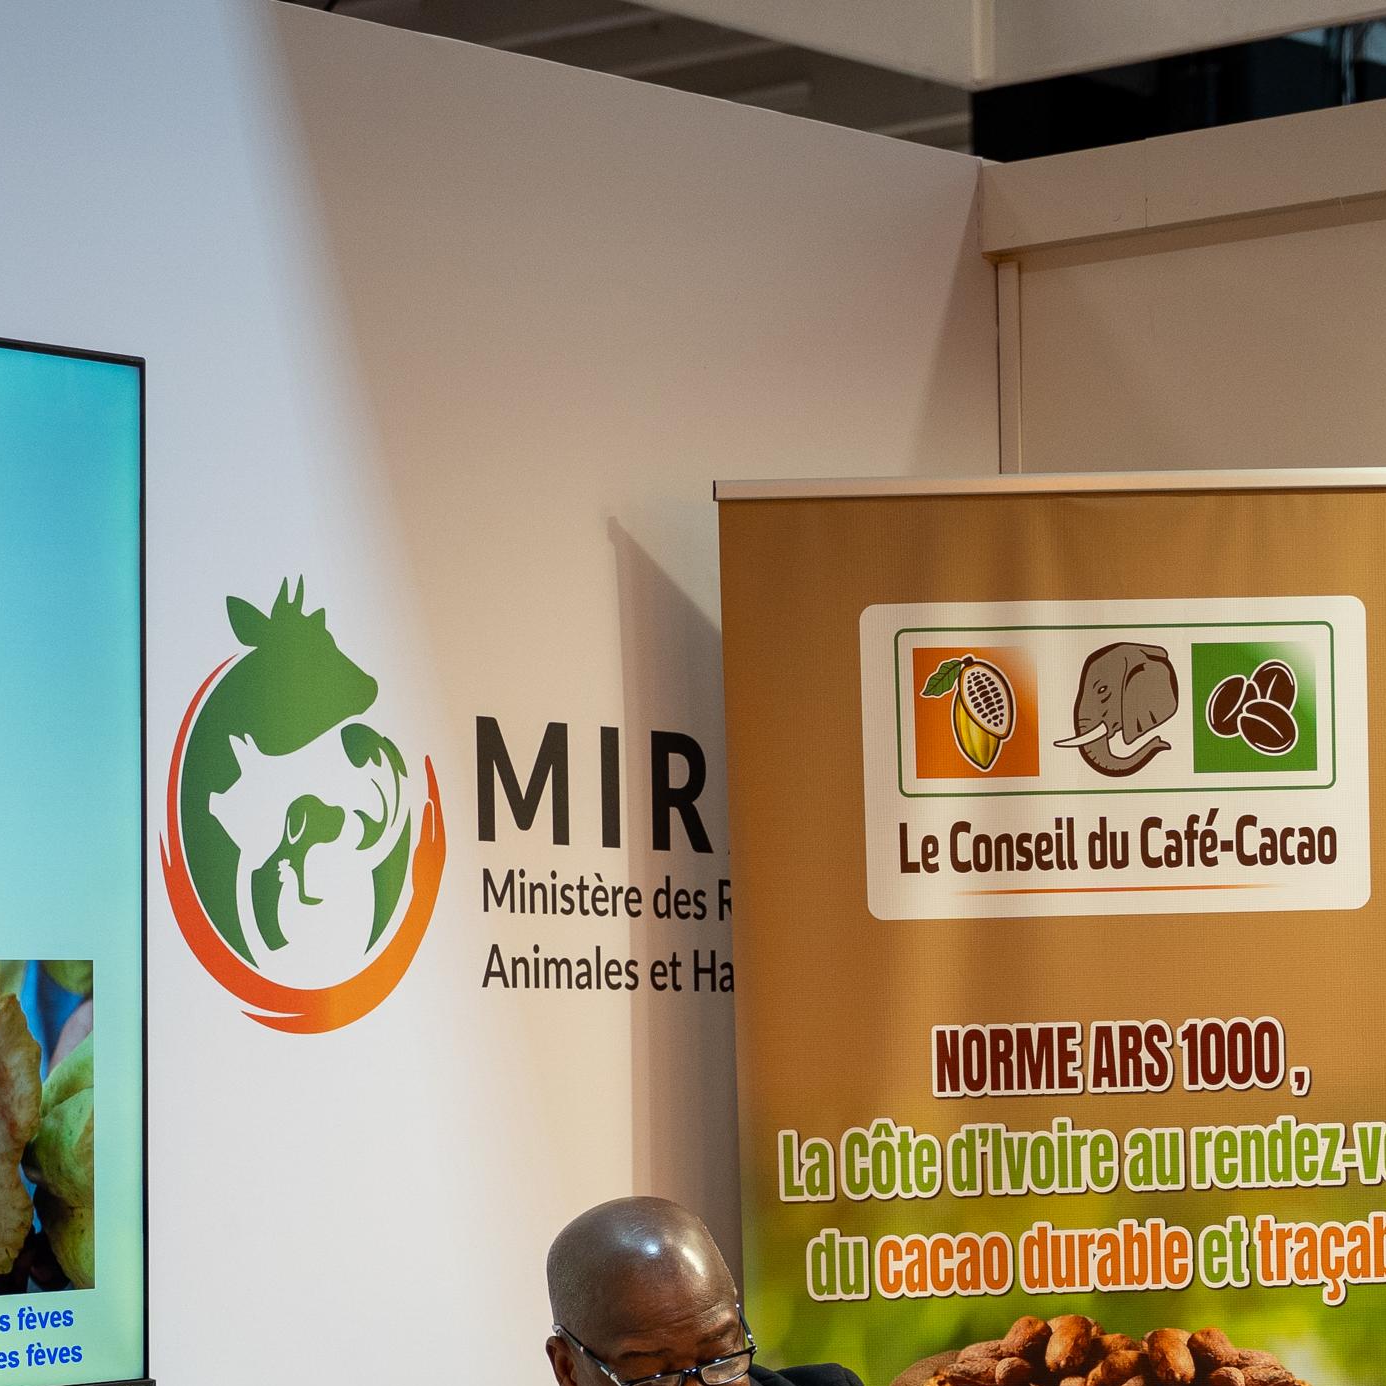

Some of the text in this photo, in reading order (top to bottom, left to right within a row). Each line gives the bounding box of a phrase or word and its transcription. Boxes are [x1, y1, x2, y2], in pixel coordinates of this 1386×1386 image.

[475, 715, 730, 854] MIR
[898, 807, 1338, 874] Le Conseil du Café-Cacao
[482, 867, 643, 918] Ministère
[652, 875, 708, 921] des
[481, 943, 640, 992] Animales
[649, 951, 683, 992] et
[934, 1025, 1079, 1094] NORME
[1089, 1021, 1171, 1091] ARS
[782, 1131, 832, 1200] La
[843, 1118, 938, 1198] Côte
[950, 1118, 1116, 1195] d'Ivoire
[1128, 1129, 1184, 1191] au
[809, 1229, 868, 1299] du
[877, 1233, 1013, 1296] cacao
[1020, 1221, 1191, 1293] durable
[1202, 1218, 1247, 1289] et
[17, 1306, 75, 1331] fèves
[26, 1341, 83, 1367] fèves
